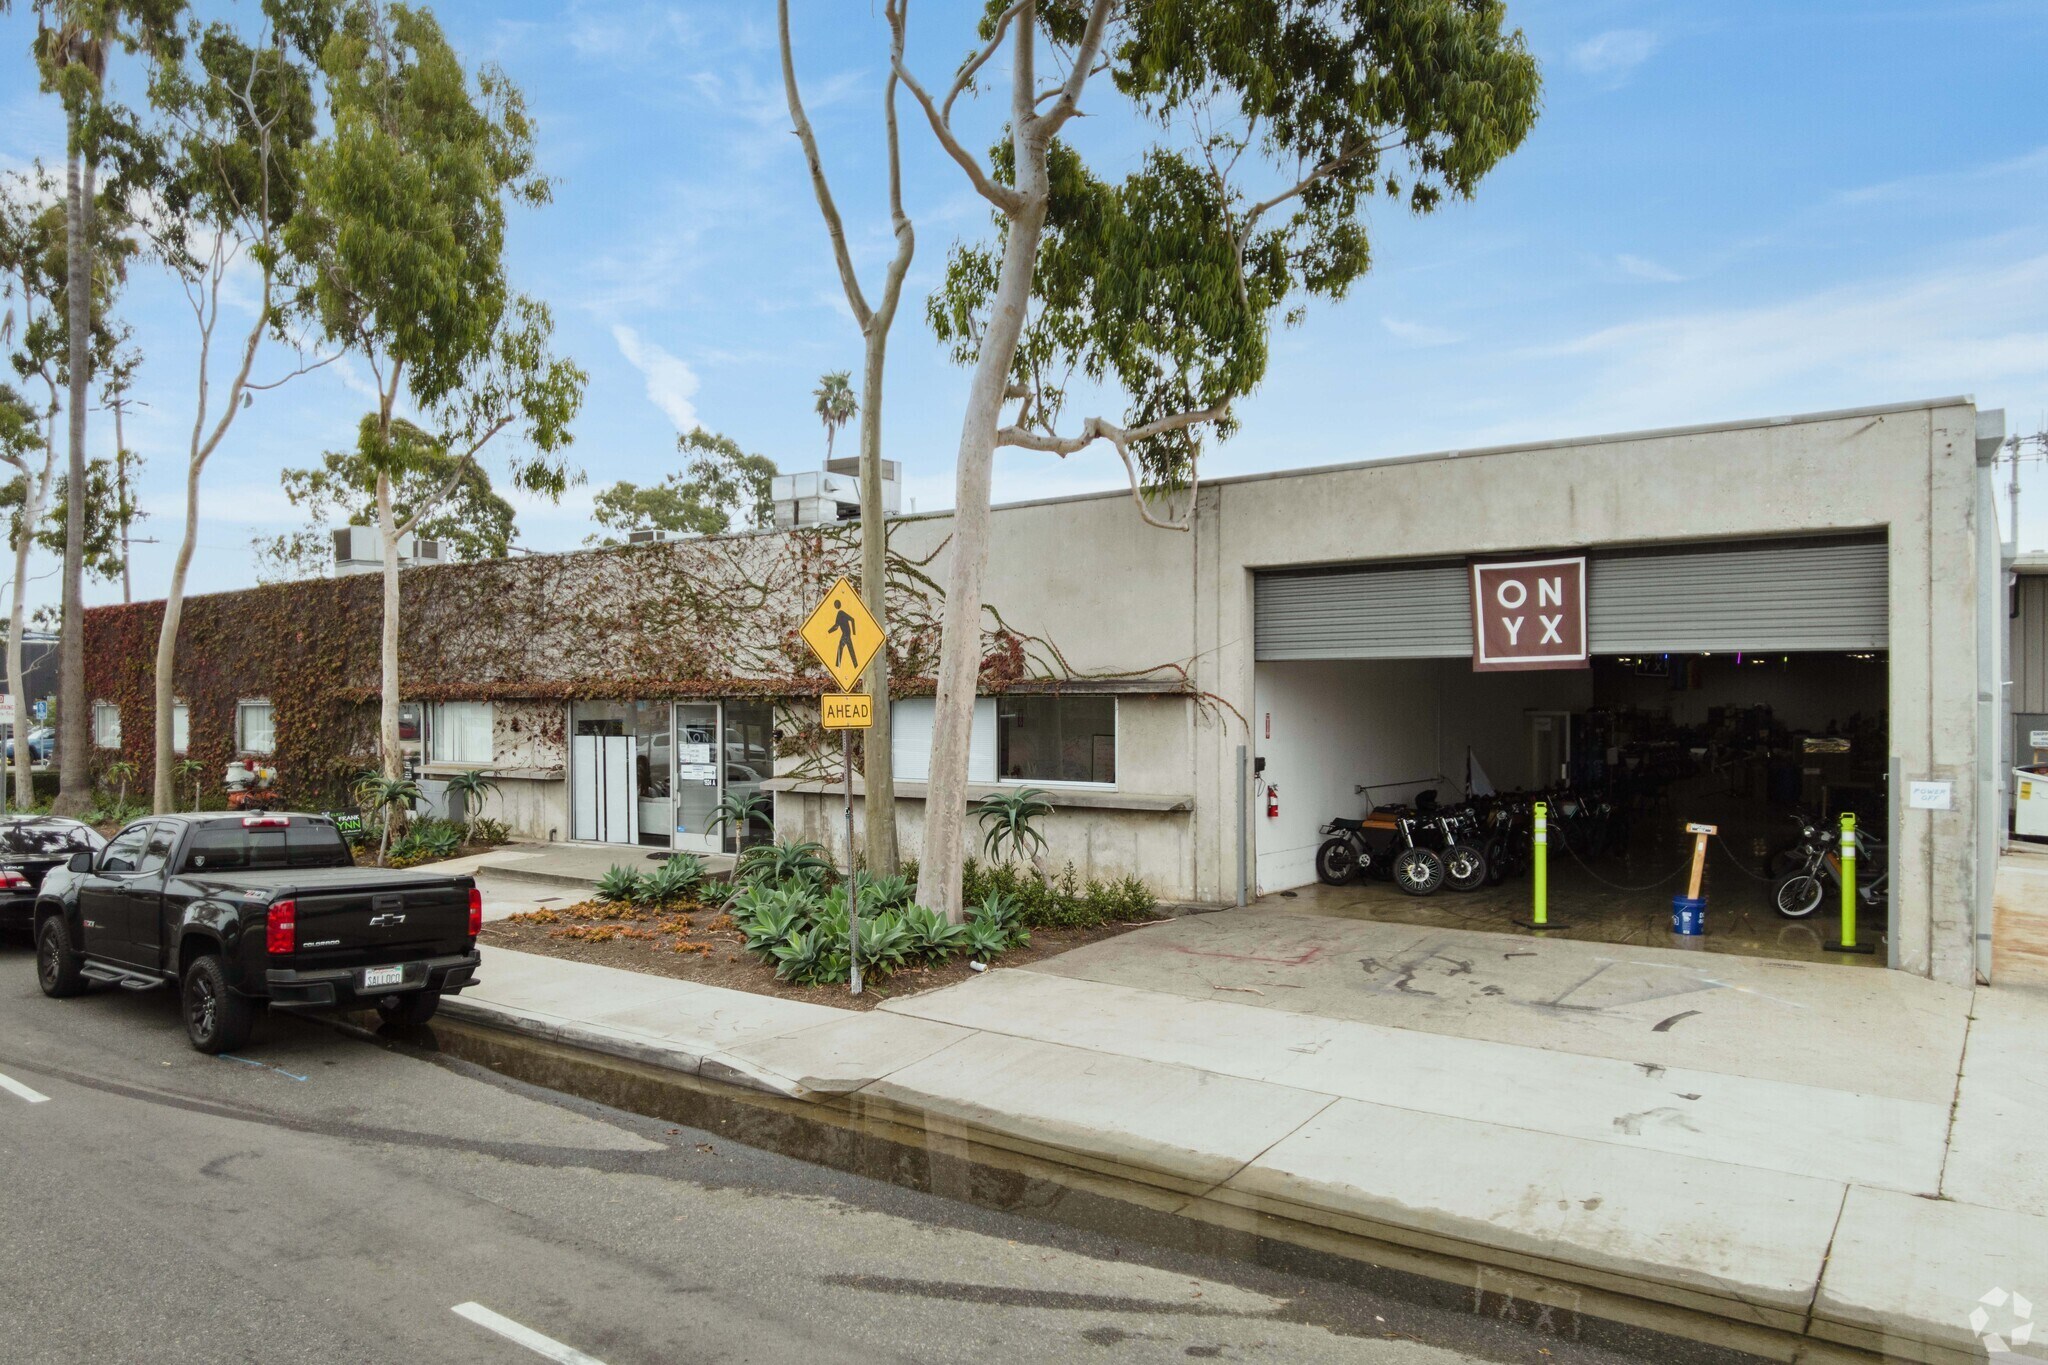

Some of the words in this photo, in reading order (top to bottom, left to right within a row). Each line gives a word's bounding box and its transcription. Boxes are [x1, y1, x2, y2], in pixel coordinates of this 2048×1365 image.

[1497, 577, 1562, 609] ON
[1502, 615, 1563, 646] YX
[827, 704, 869, 718] AHEAD
[336, 820, 361, 830] YNN
[303, 940, 340, 948] COLORADO
